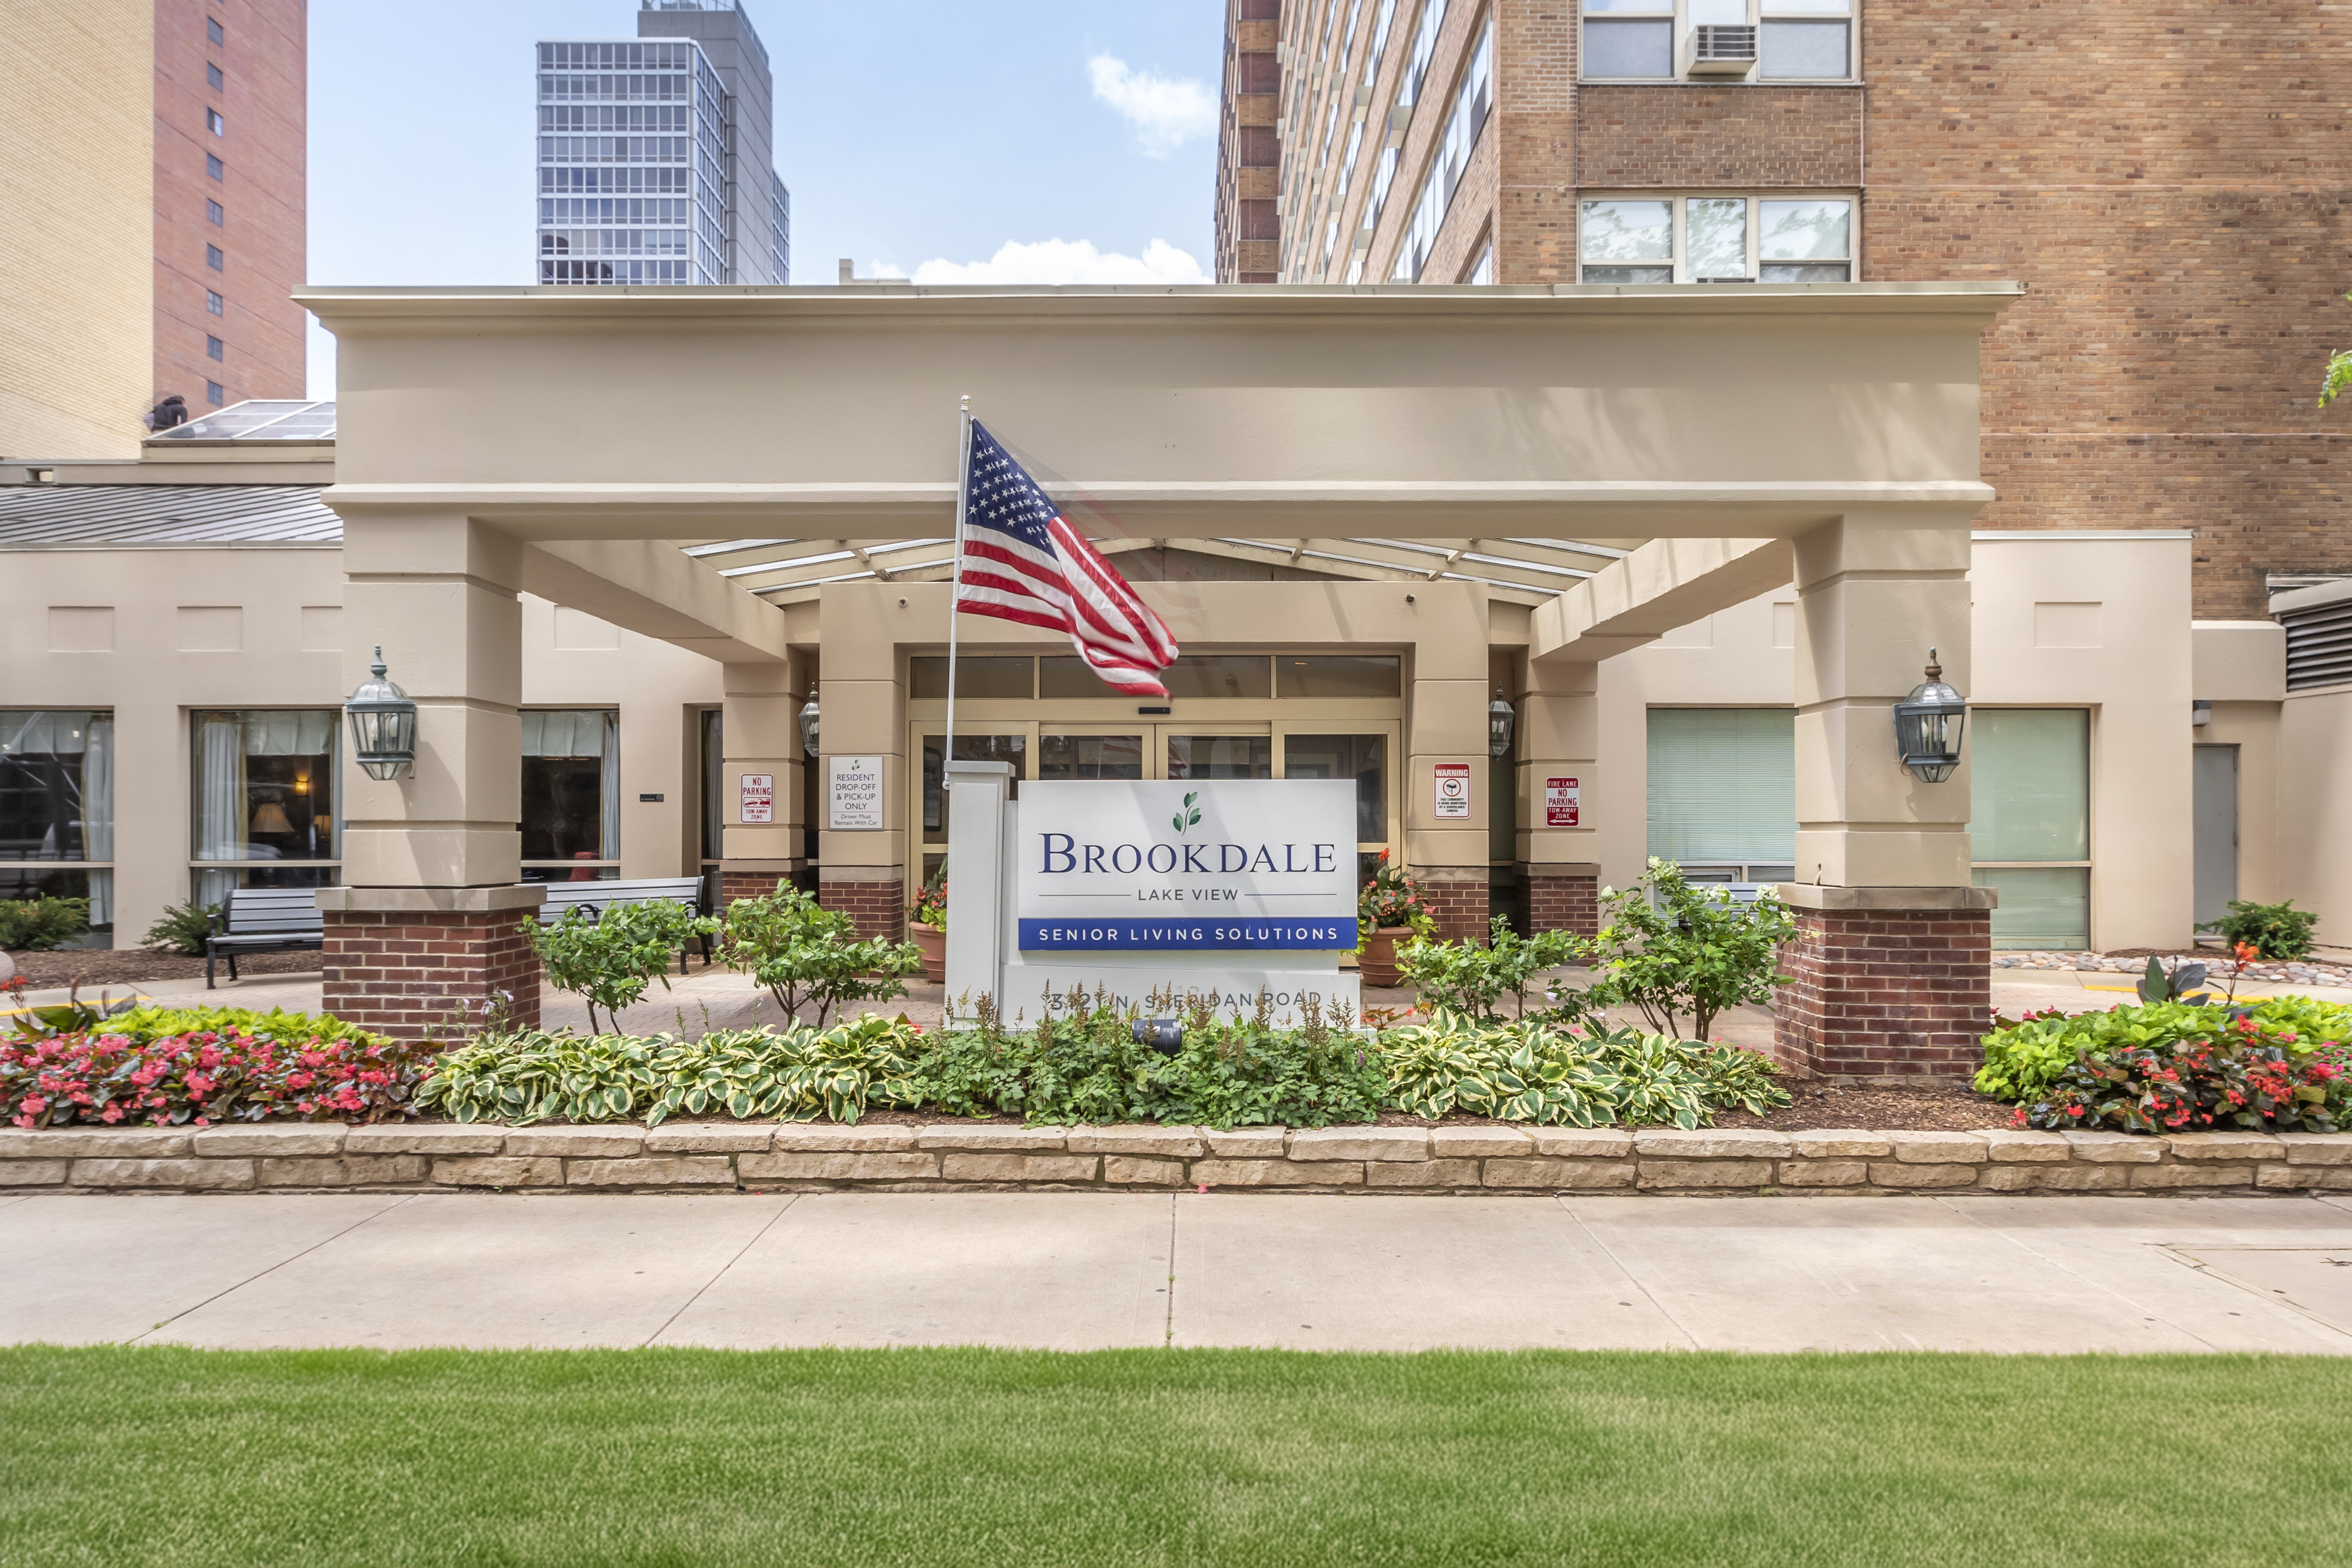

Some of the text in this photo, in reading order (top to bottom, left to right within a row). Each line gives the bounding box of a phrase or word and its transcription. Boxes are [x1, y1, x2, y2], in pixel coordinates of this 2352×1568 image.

[1558, 789, 1567, 797] NO
[1038, 833, 1337, 873] BROOKDALE
[1138, 889, 1238, 900] LAKE VIEW
[1039, 928, 1337, 941] SENIOR LIVING SOLUTIONS
[1116, 996, 1128, 1009] N
[1145, 993, 1251, 1009] SEDAN
